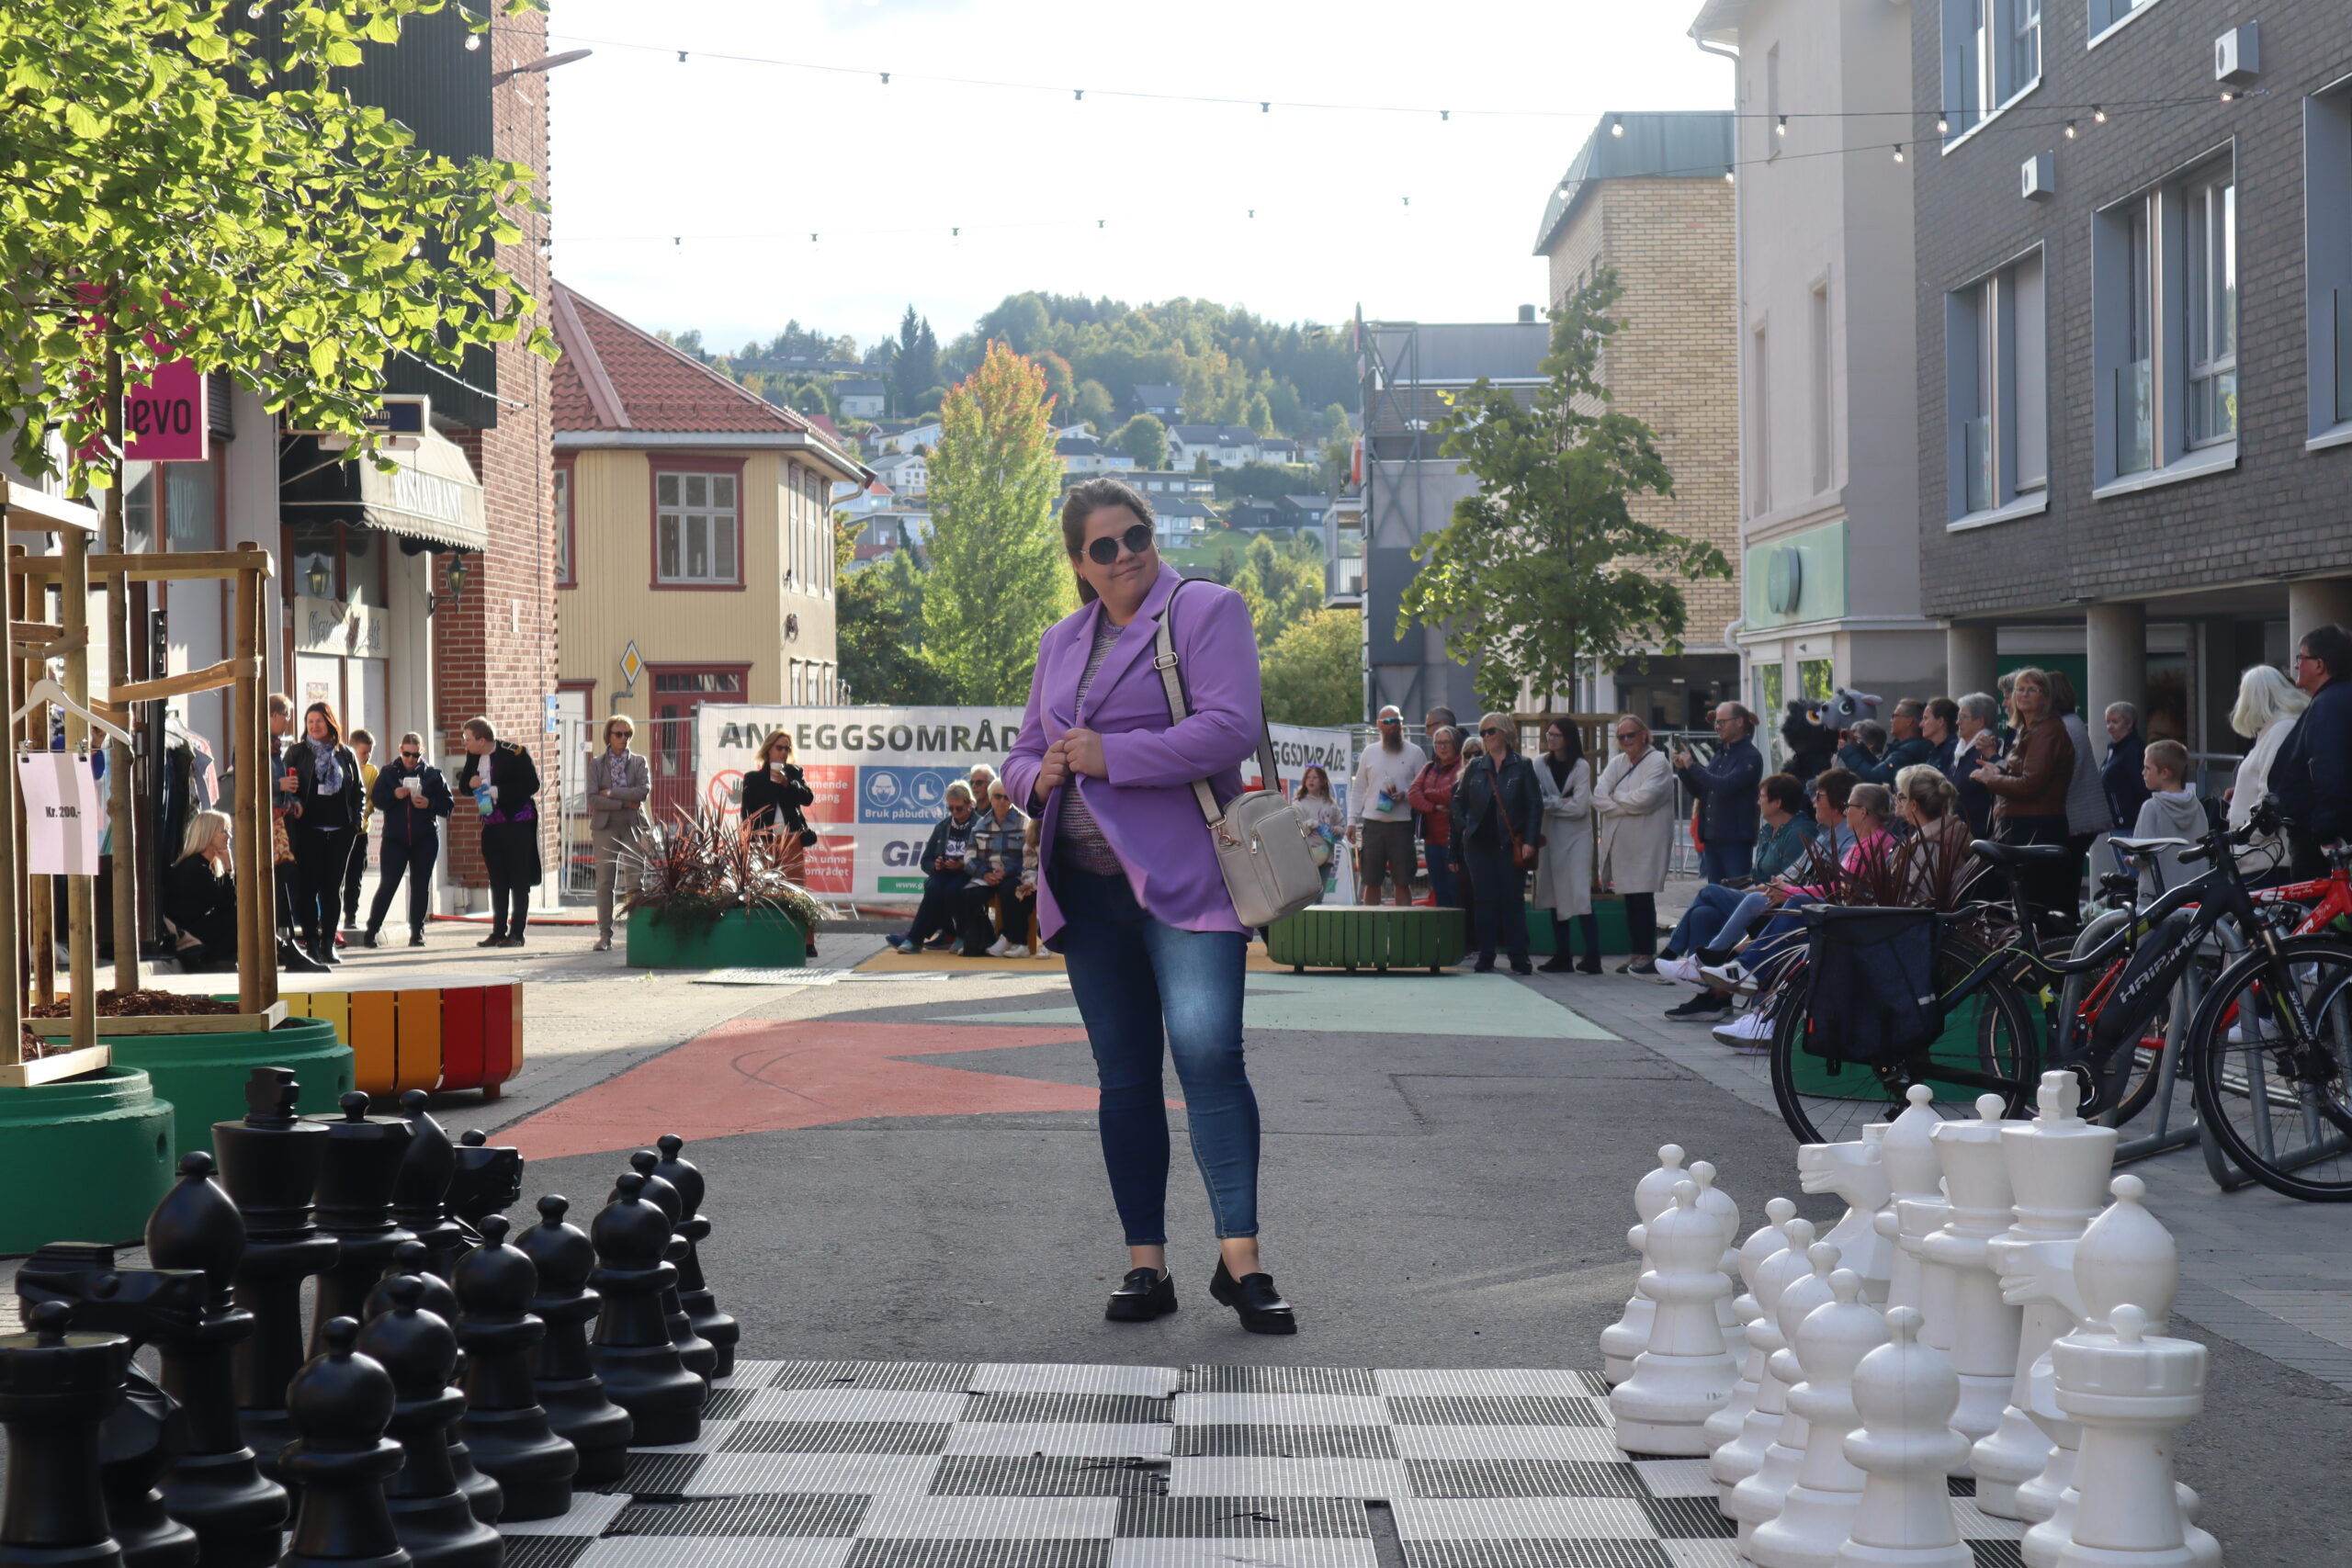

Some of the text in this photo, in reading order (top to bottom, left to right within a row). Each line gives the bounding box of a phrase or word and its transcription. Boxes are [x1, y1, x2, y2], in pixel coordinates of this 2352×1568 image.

[393, 468, 464, 525] RESTAURANT
[718, 718, 1021, 752] ANEGGSOMRÅD
[1272, 741, 1346, 772] GGSOMRÅDE
[45, 806, 81, 818] Kr. 200,-
[865, 809, 889, 818] Bruk
[892, 808, 928, 820] påbudt
[895, 882, 923, 890] www.g
